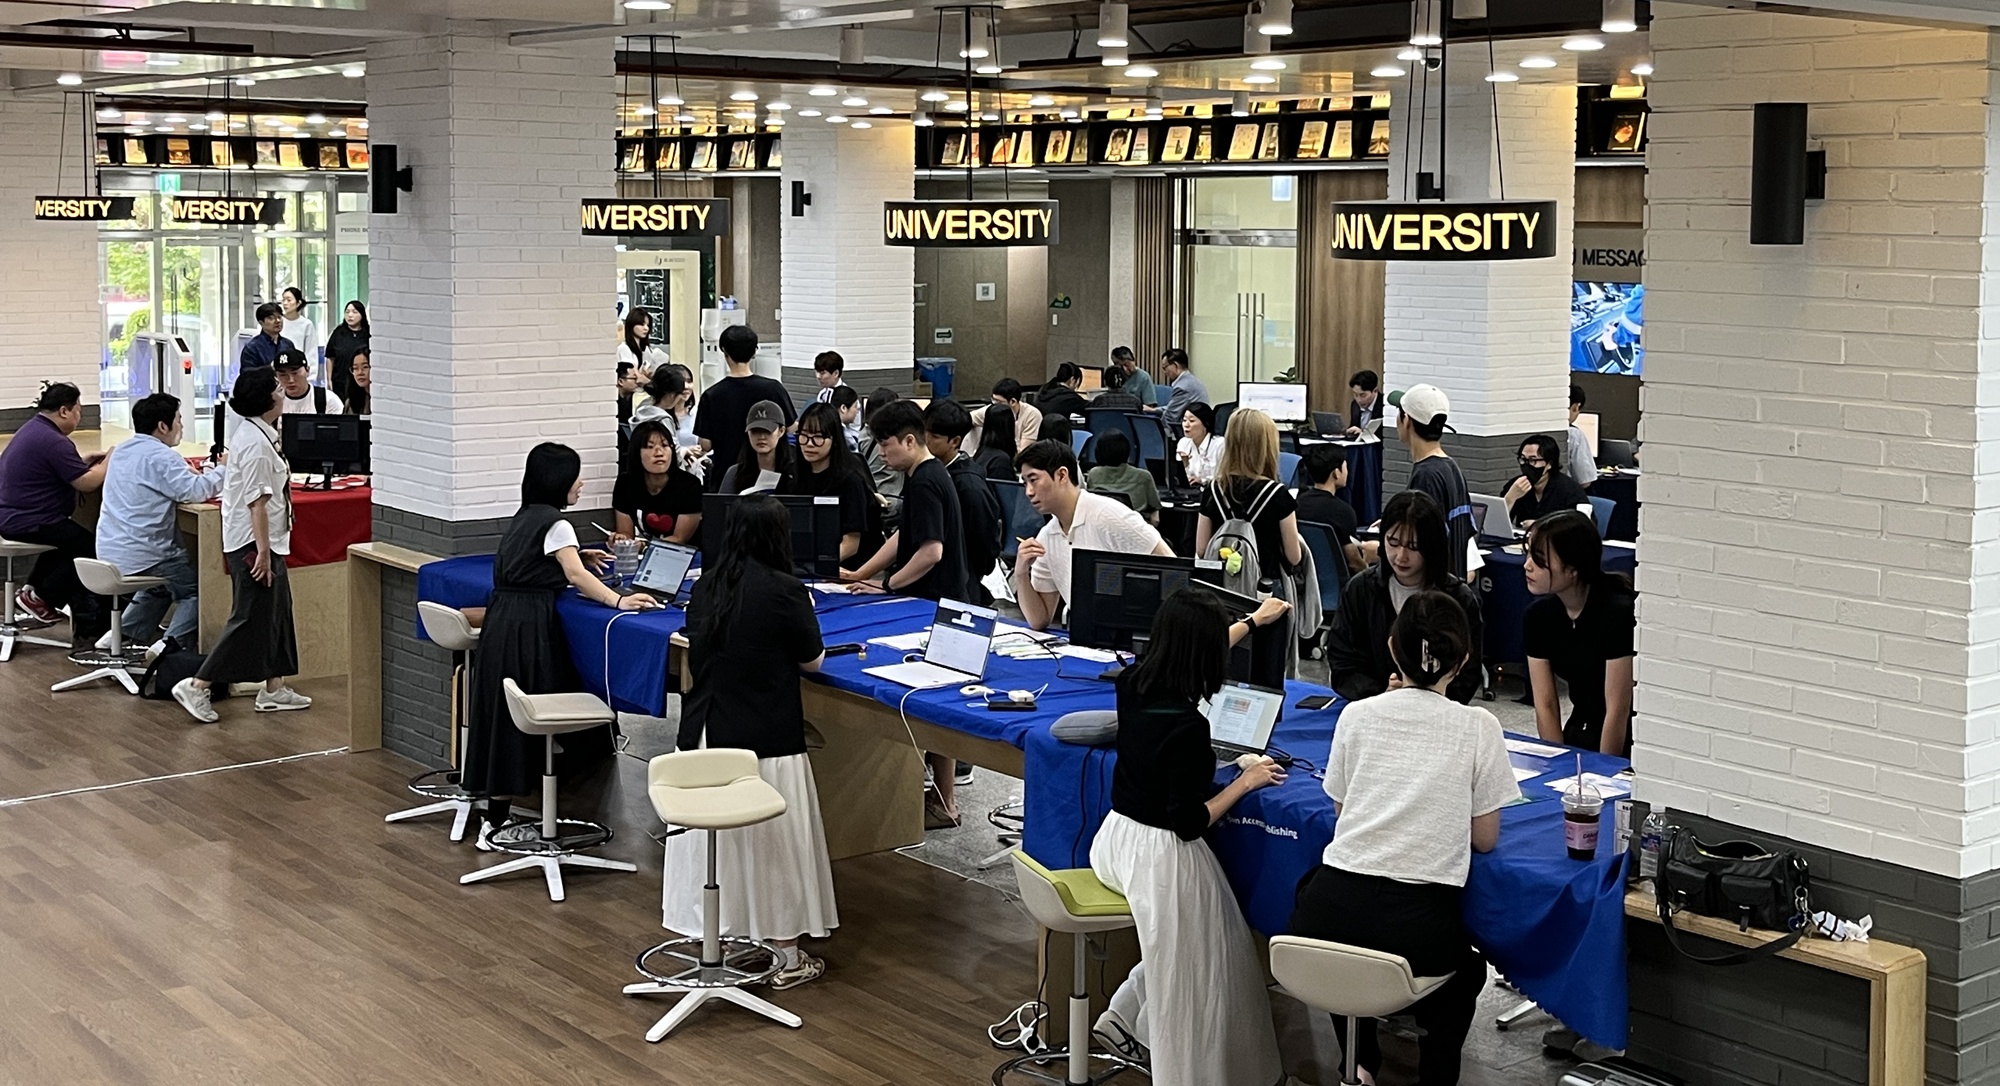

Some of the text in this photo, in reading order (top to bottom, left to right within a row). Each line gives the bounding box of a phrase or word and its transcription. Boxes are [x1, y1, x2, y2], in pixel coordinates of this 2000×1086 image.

[173, 201, 264, 220] IVERSITY
[582, 205, 710, 231] NIVERSITY
[886, 208, 1052, 240] UNIVERSITY
[1331, 212, 1540, 252] UNIVERSITY
